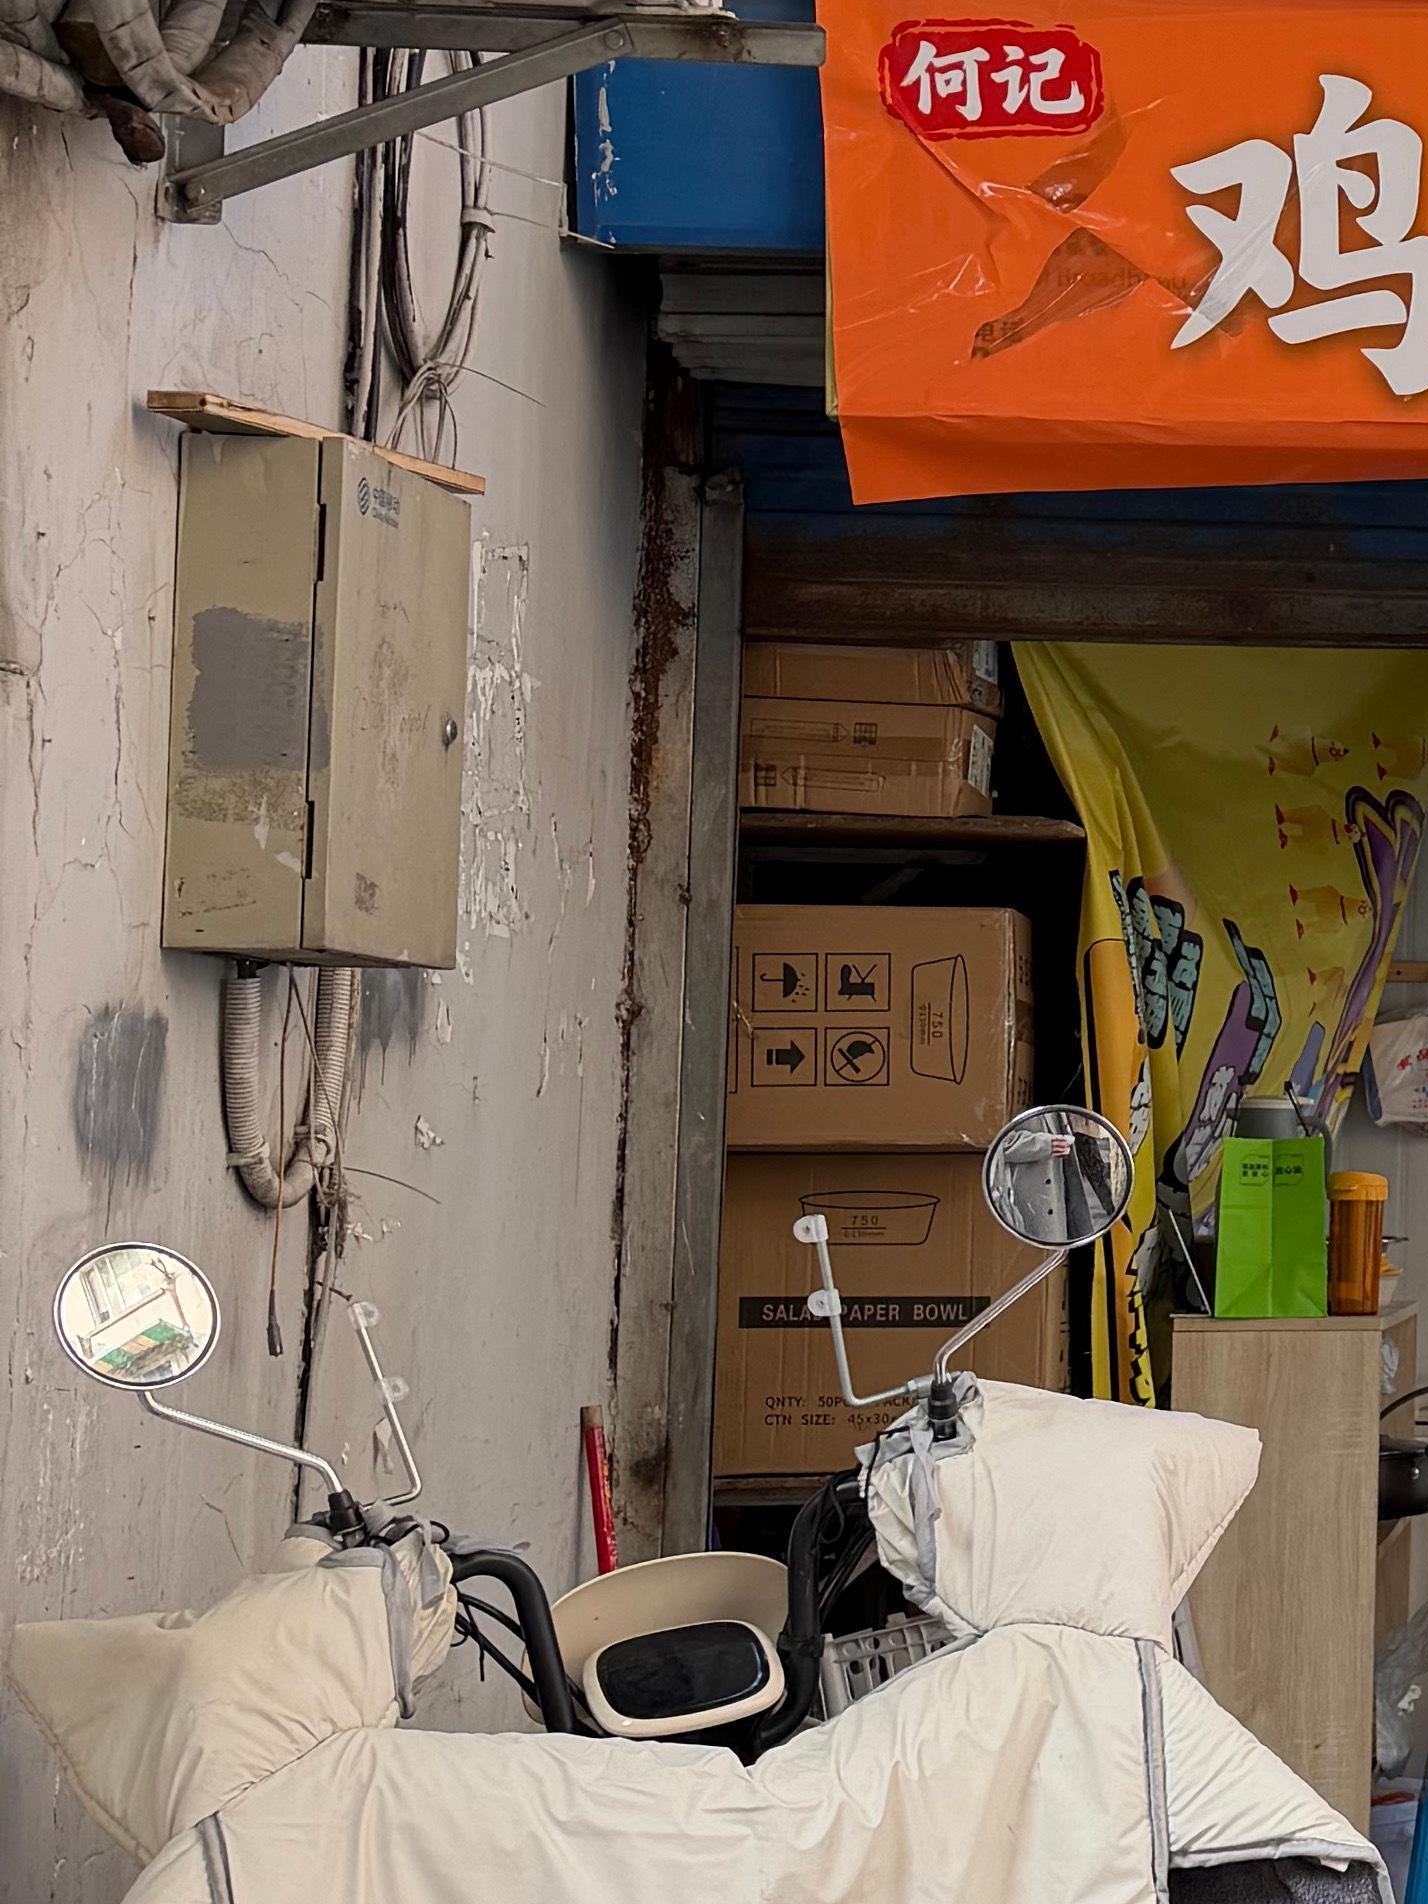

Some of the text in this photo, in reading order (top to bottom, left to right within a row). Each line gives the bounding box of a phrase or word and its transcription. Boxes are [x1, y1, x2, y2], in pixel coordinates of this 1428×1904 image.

[900, 40, 1085, 121] 何记
[931, 1011, 944, 1039] 750
[851, 1215, 879, 1226] 750
[762, 1304, 822, 1321] SALA
[913, 1303, 968, 1321] BOWL
[764, 1413, 792, 1426] CTN
[801, 1413, 836, 1426] SIZE:
